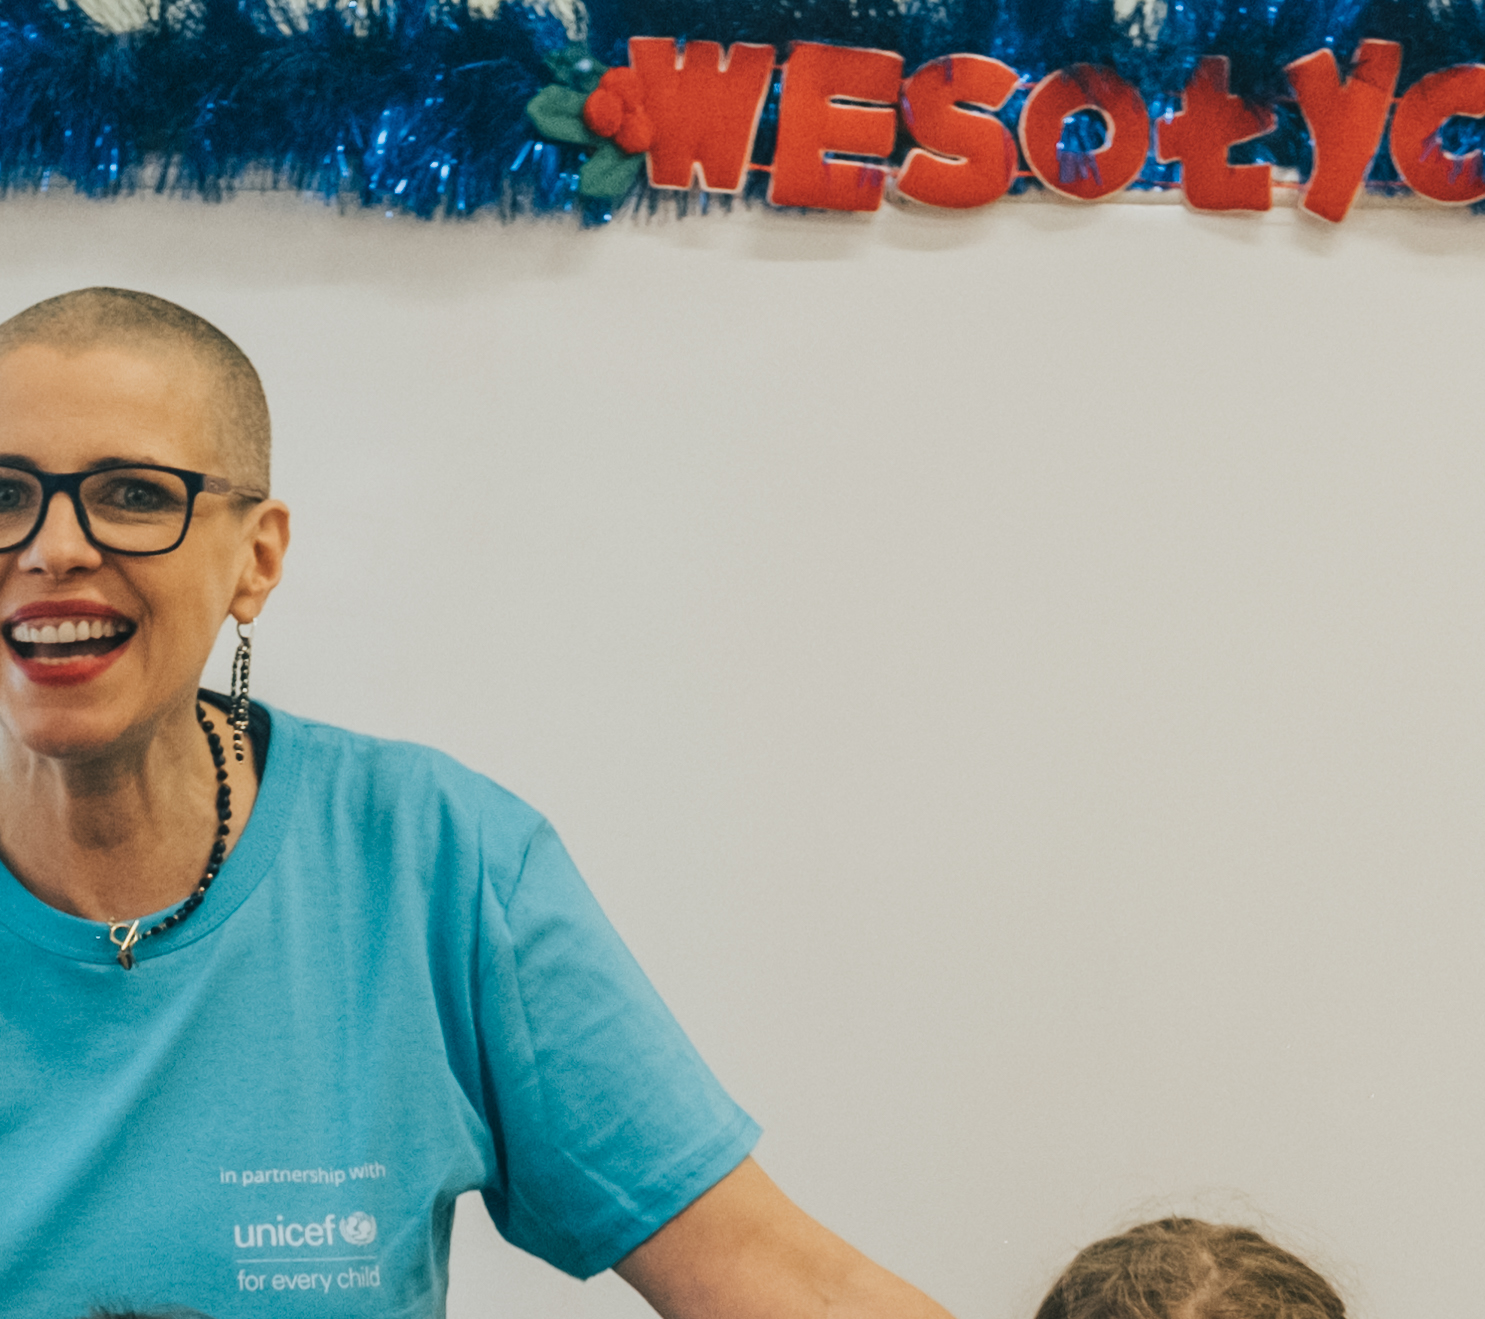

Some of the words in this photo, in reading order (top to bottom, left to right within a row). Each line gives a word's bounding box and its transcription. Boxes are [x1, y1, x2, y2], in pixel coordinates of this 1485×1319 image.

[219, 1166, 237, 1184] in
[241, 1166, 346, 1187] partnership
[348, 1161, 387, 1181] with
[233, 1213, 337, 1248] unicef
[236, 1268, 266, 1292] for
[271, 1270, 332, 1294] every
[336, 1264, 382, 1290] child
